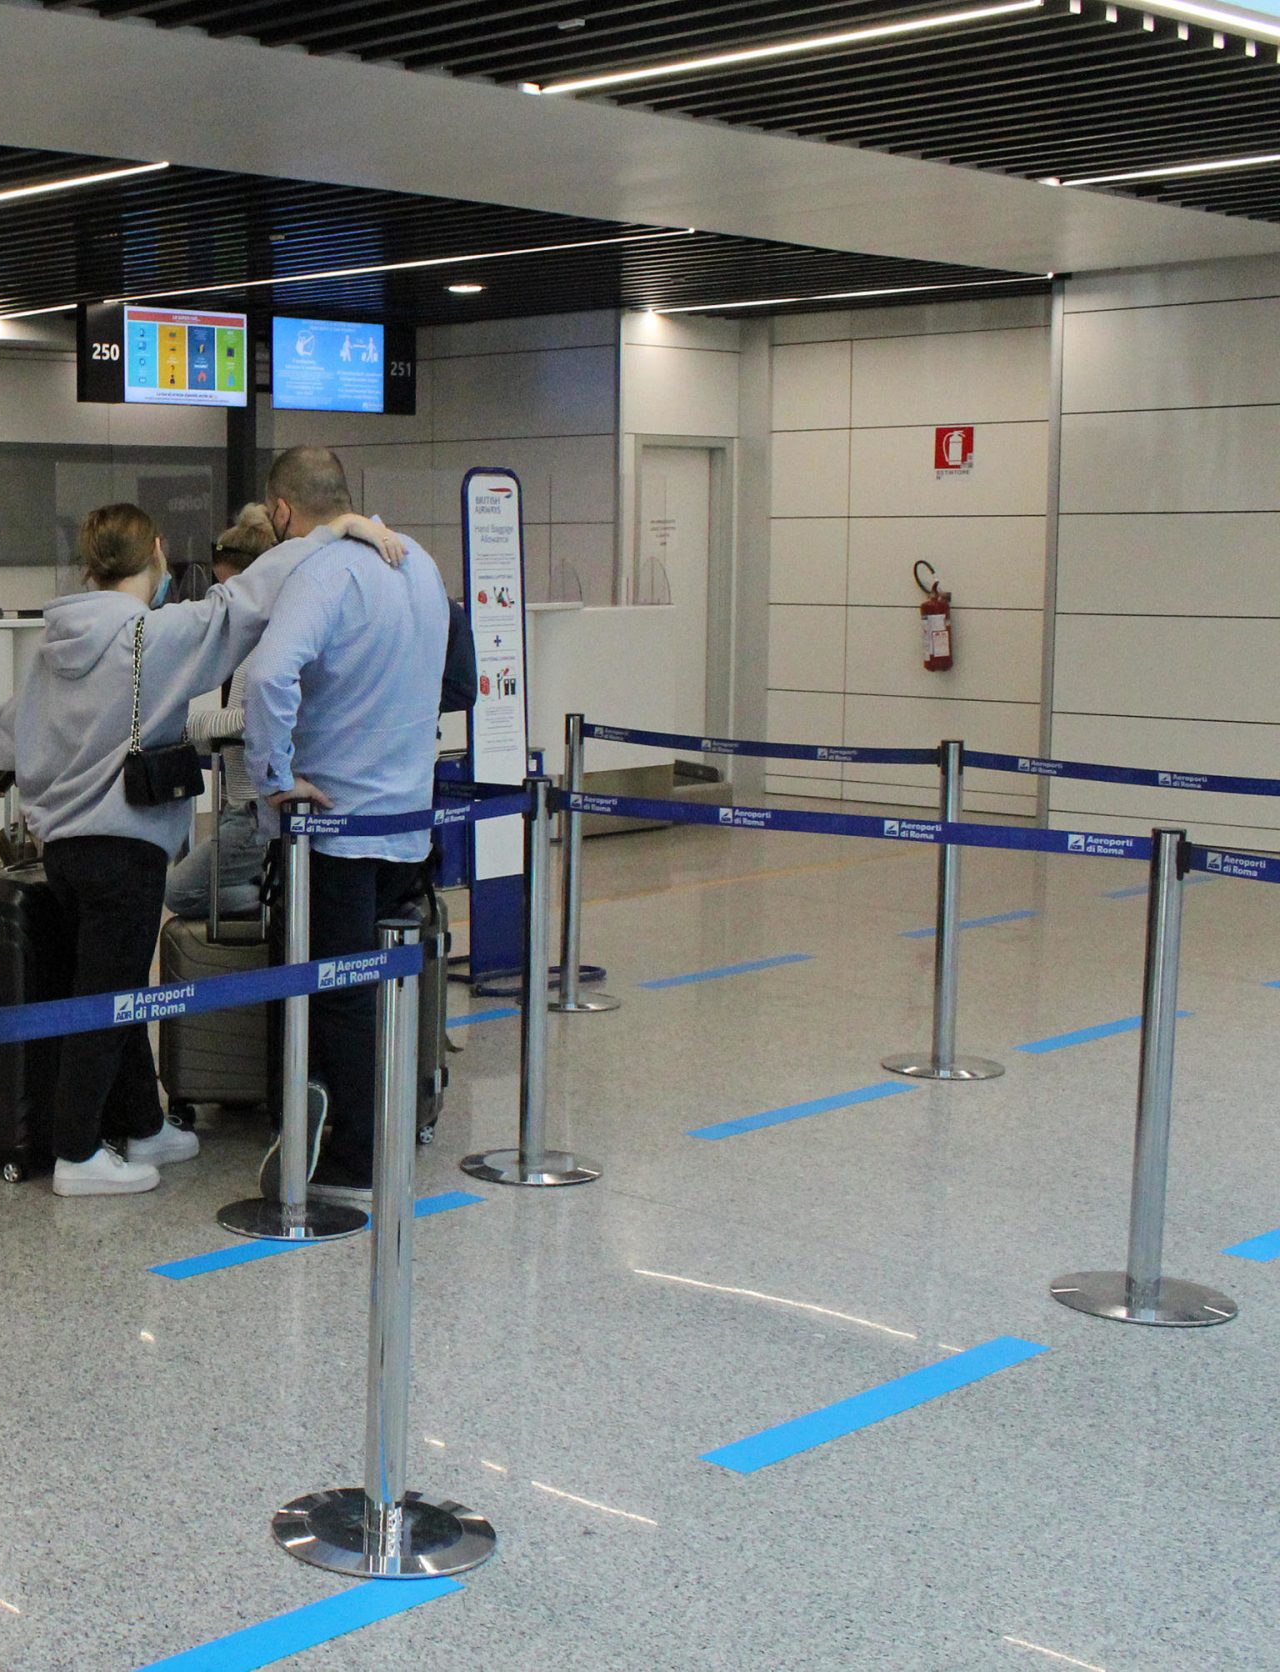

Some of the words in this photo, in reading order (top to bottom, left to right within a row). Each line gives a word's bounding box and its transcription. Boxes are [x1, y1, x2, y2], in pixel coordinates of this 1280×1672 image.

[92, 342, 120, 361] 250
[390, 361, 412, 378] 251
[1030, 760, 1064, 770] Aeroporti
[1038, 767, 1057, 775] Roma
[1172, 774, 1208, 782] Aeroporti
[583, 796, 618, 805] Aeroporti
[591, 804, 612, 812] Roma
[734, 809, 772, 818] Aeroporti
[306, 816, 348, 826] Aeroporti
[743, 818, 766, 826] Roma
[900, 822, 942, 832] Aeroporti
[900, 830, 909, 838] di
[910, 832, 934, 840] Roma
[1086, 836, 1134, 847] Aeroporti
[1096, 846, 1124, 855] Roma
[1224, 854, 1266, 868] Aeroporti
[1232, 866, 1258, 876] Roma
[336, 952, 388, 972] Aeroporti
[336, 972, 346, 986] di
[350, 969, 380, 982] Roma
[136, 984, 194, 1005] Aeroporti
[136, 1006, 147, 1020] di
[150, 1002, 186, 1017] Roma
